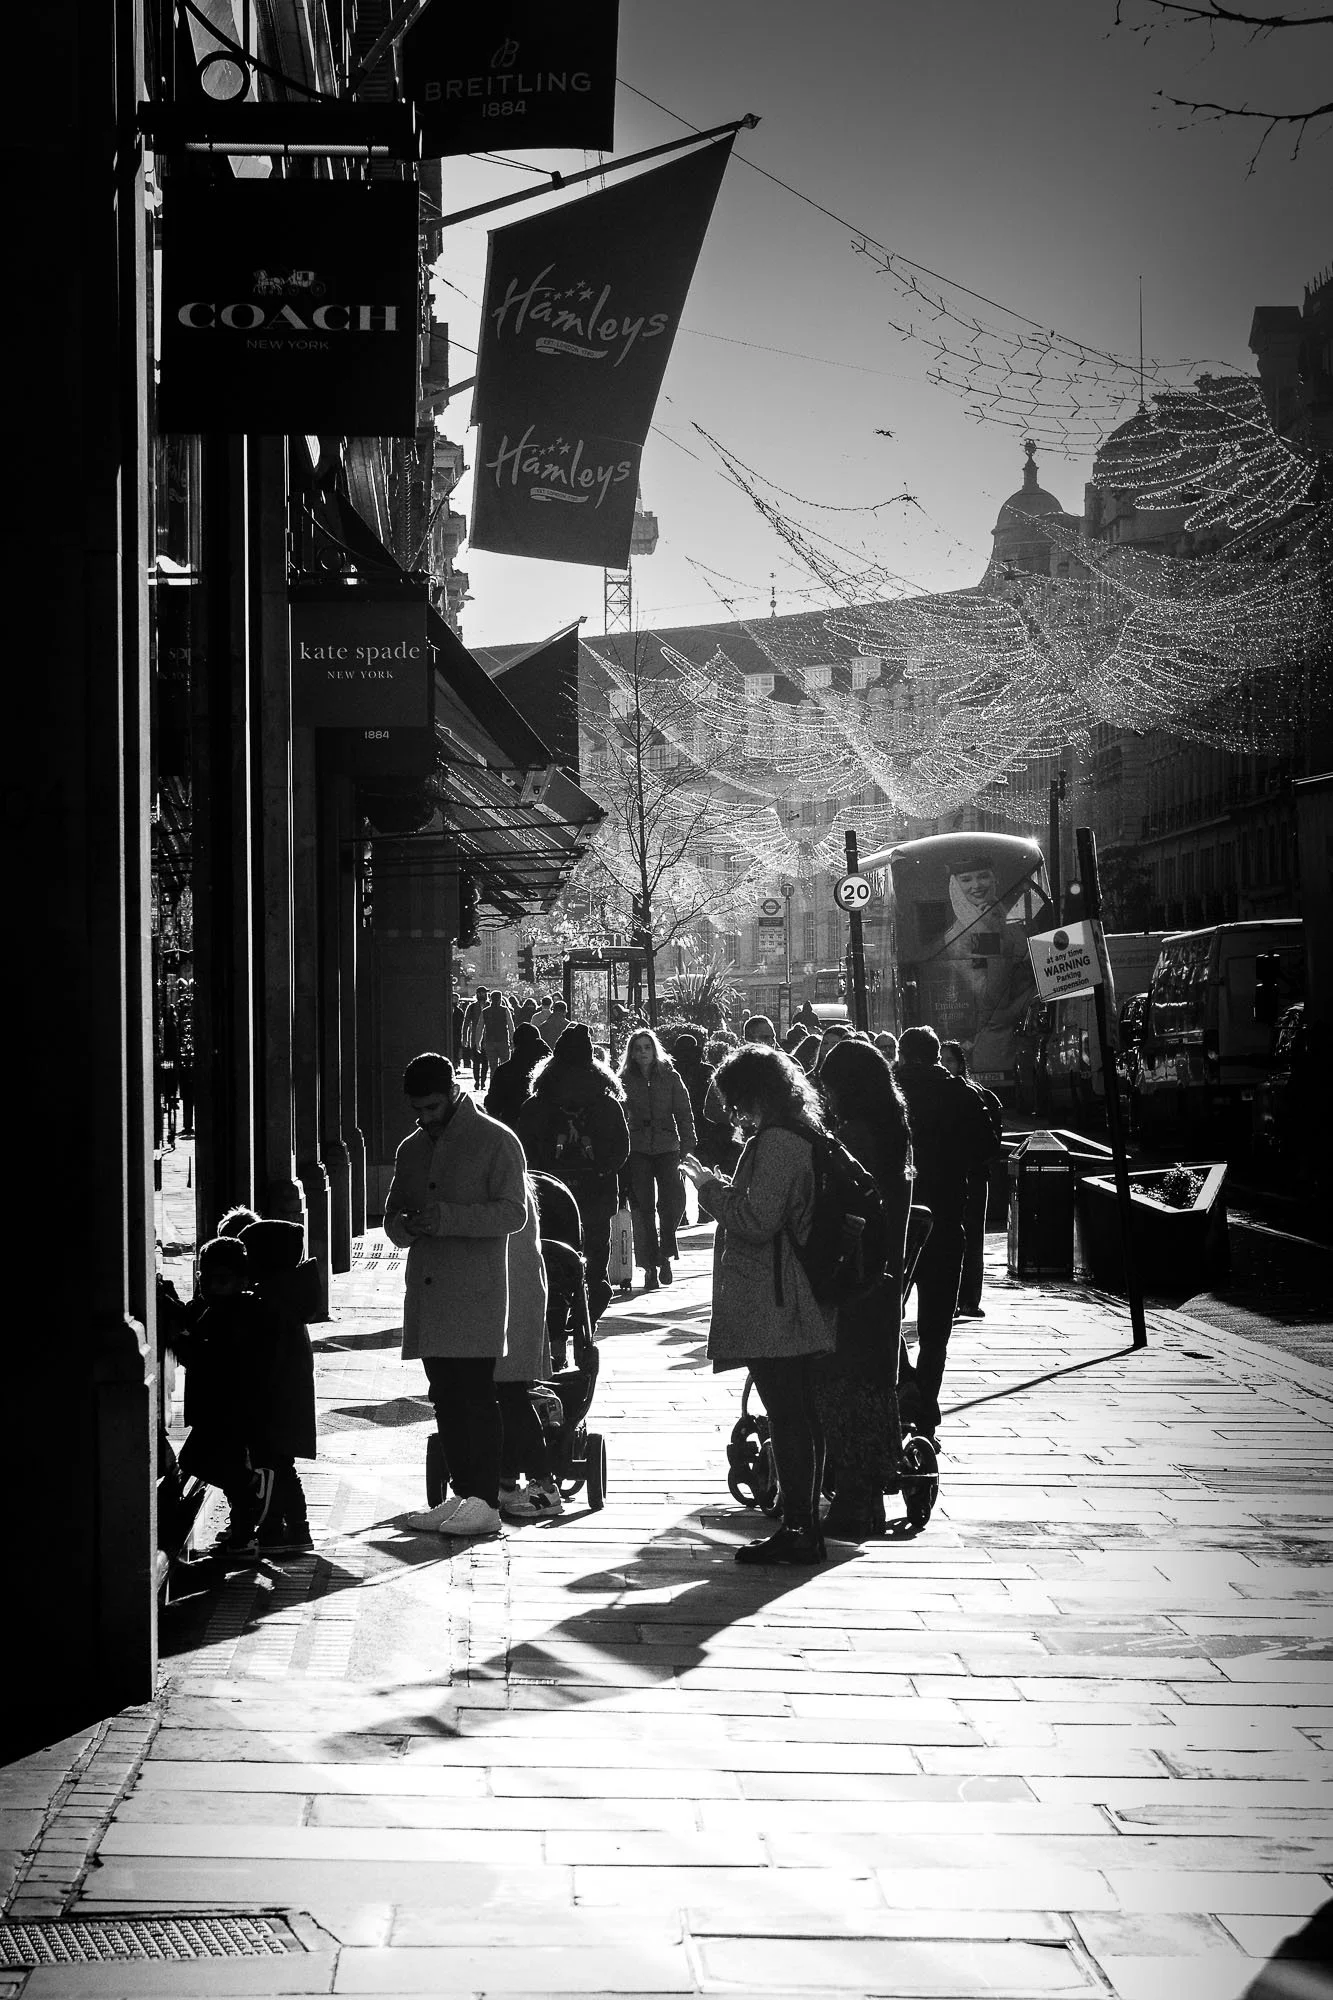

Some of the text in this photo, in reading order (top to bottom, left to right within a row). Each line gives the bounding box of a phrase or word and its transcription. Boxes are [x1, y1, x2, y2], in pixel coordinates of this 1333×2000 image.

[424, 71, 593, 103] BREITLING
[481, 100, 527, 119] 1884
[177, 302, 401, 332] COACH
[491, 263, 669, 367] Hamleys
[246, 340, 330, 350] NEW YORK
[486, 424, 631, 509] Hamleys
[300, 641, 420, 666] kate spade
[327, 671, 394, 680] NEW YORK
[364, 730, 390, 740] 1884
[843, 884, 869, 900] 20
[1046, 948, 1083, 964] at any time
[1043, 955, 1091, 977] WARNING
[1053, 977, 1090, 993] suspension
[1056, 970, 1082, 983] Parking
